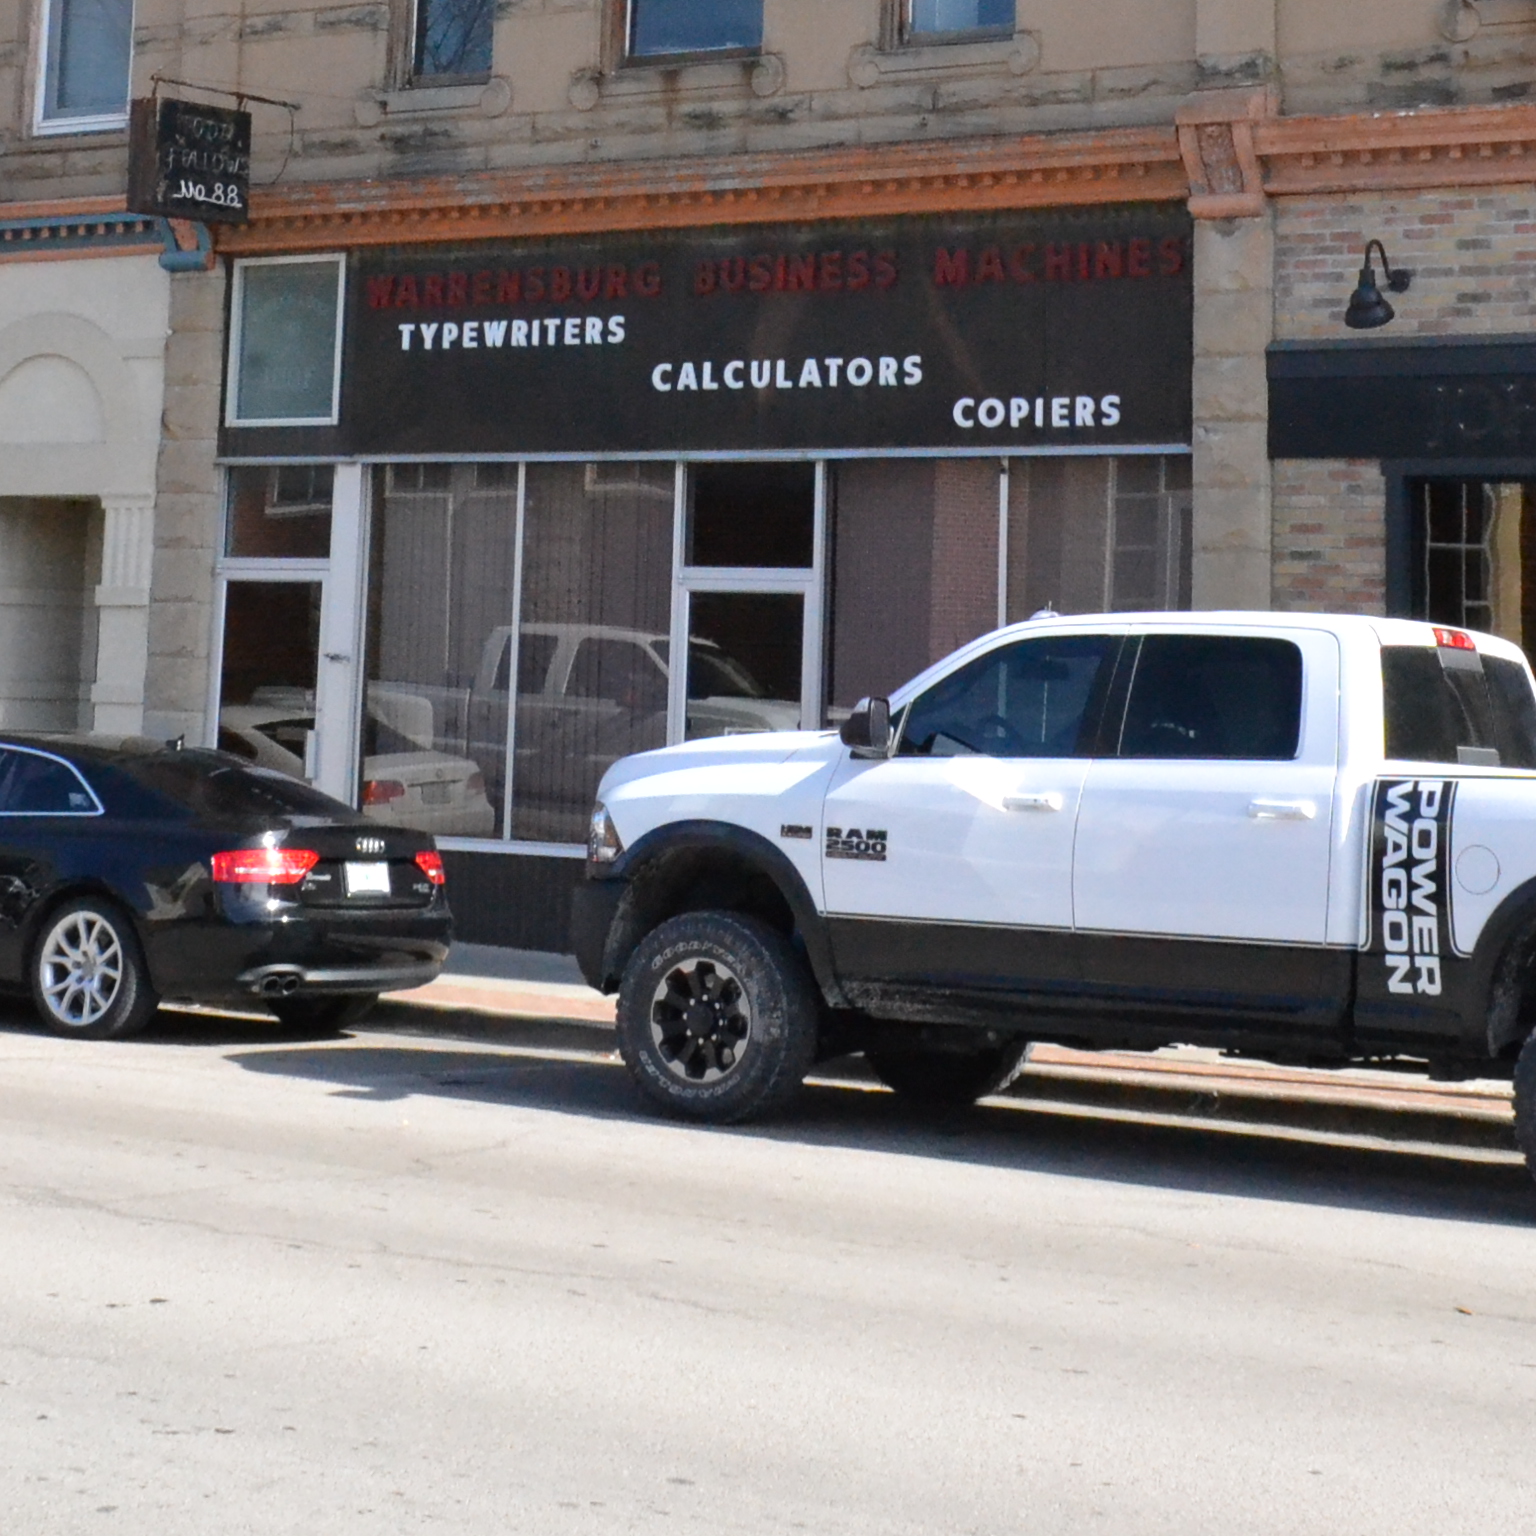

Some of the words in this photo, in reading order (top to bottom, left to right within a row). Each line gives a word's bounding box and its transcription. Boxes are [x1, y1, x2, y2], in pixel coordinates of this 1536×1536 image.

[366, 262, 661, 310] WARRENSBURG
[693, 249, 898, 296] BUSINESS
[933, 237, 1185, 290] MACHINES
[398, 315, 626, 352] TYPEWRITERS
[651, 354, 924, 393] CALCULATORS
[952, 394, 1122, 429] COPIERS
[825, 839, 887, 853] 2500
[826, 826, 888, 841] RAM
[1381, 781, 1413, 995] WAGON
[1411, 780, 1443, 997] POWER
